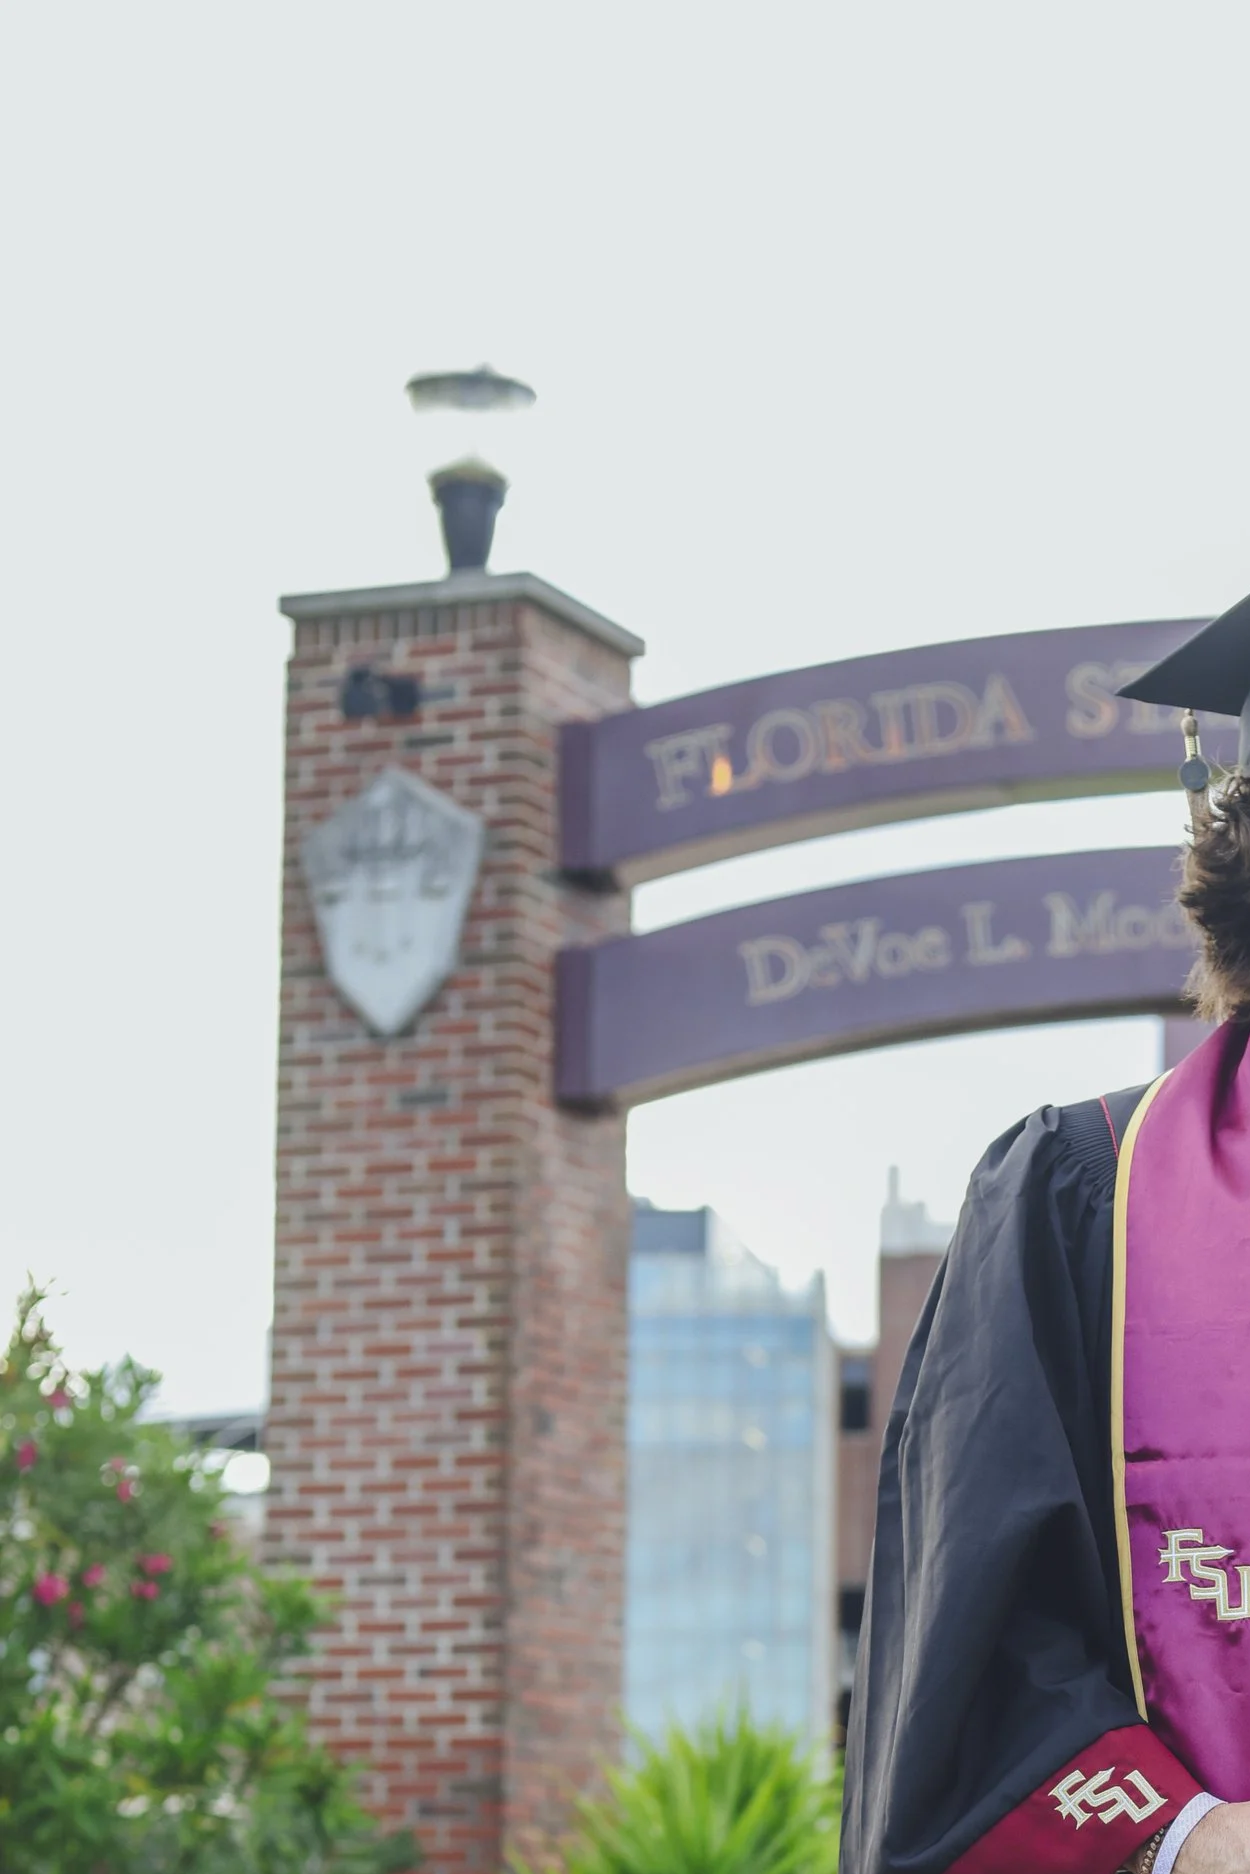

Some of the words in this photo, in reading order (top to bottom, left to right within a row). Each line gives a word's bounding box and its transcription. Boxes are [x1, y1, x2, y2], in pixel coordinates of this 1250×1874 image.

[644, 673, 1034, 811] FLORIDA
[739, 917, 951, 1006] DeVoe
[1043, 889, 1190, 958] Moo
[1048, 1765, 1169, 1831] FSU
